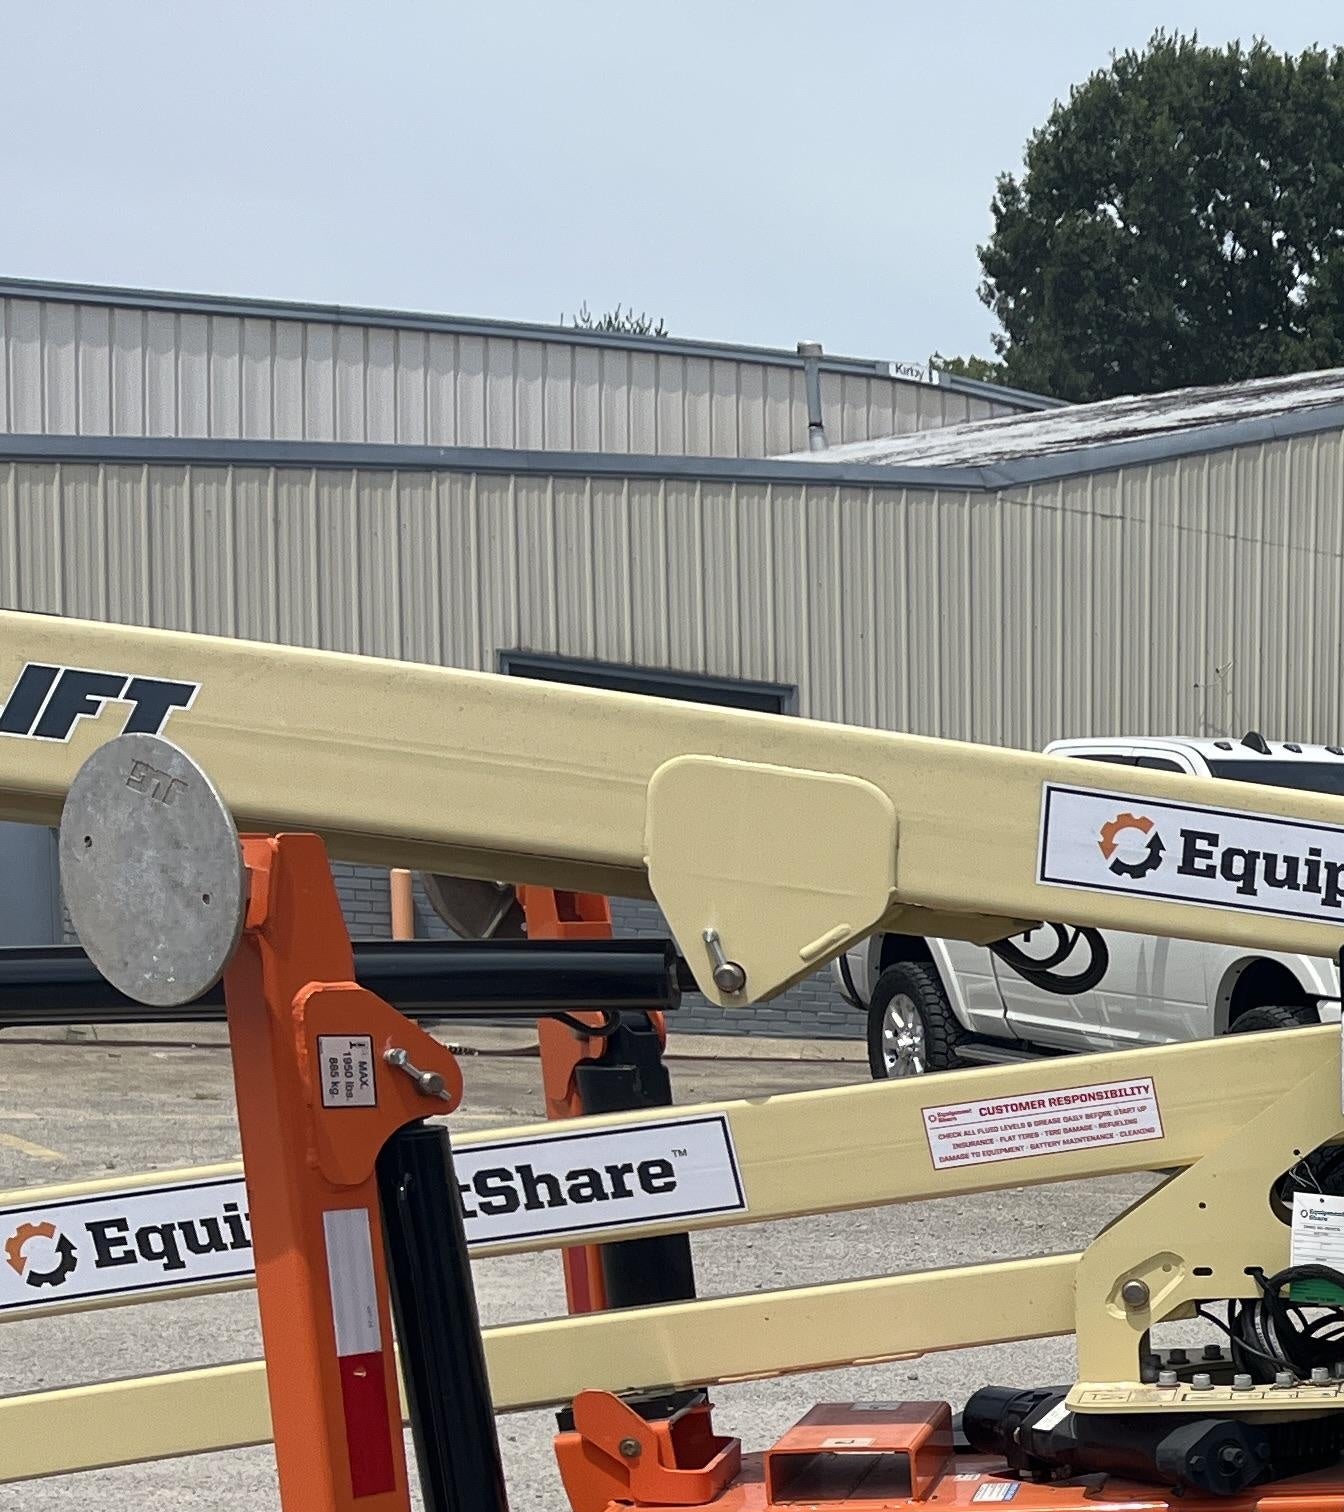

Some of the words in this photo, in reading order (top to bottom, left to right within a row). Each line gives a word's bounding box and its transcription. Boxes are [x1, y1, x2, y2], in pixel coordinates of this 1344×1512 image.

[329, 1057, 339, 1078] 885
[342, 1052, 353, 1078] 1950
[358, 1061, 369, 1089] MAX.
[979, 1099, 1046, 1117] CUSTOMER
[1048, 1085, 1150, 1107] RESPONSIBILITY
[938, 1131, 962, 1140] CHECK
[977, 1126, 999, 1135] FLUID
[1000, 1121, 1025, 1131] LEVELS
[938, 1153, 969, 1163] DAMAGE
[982, 1145, 1024, 1157] EQUIPMENT
